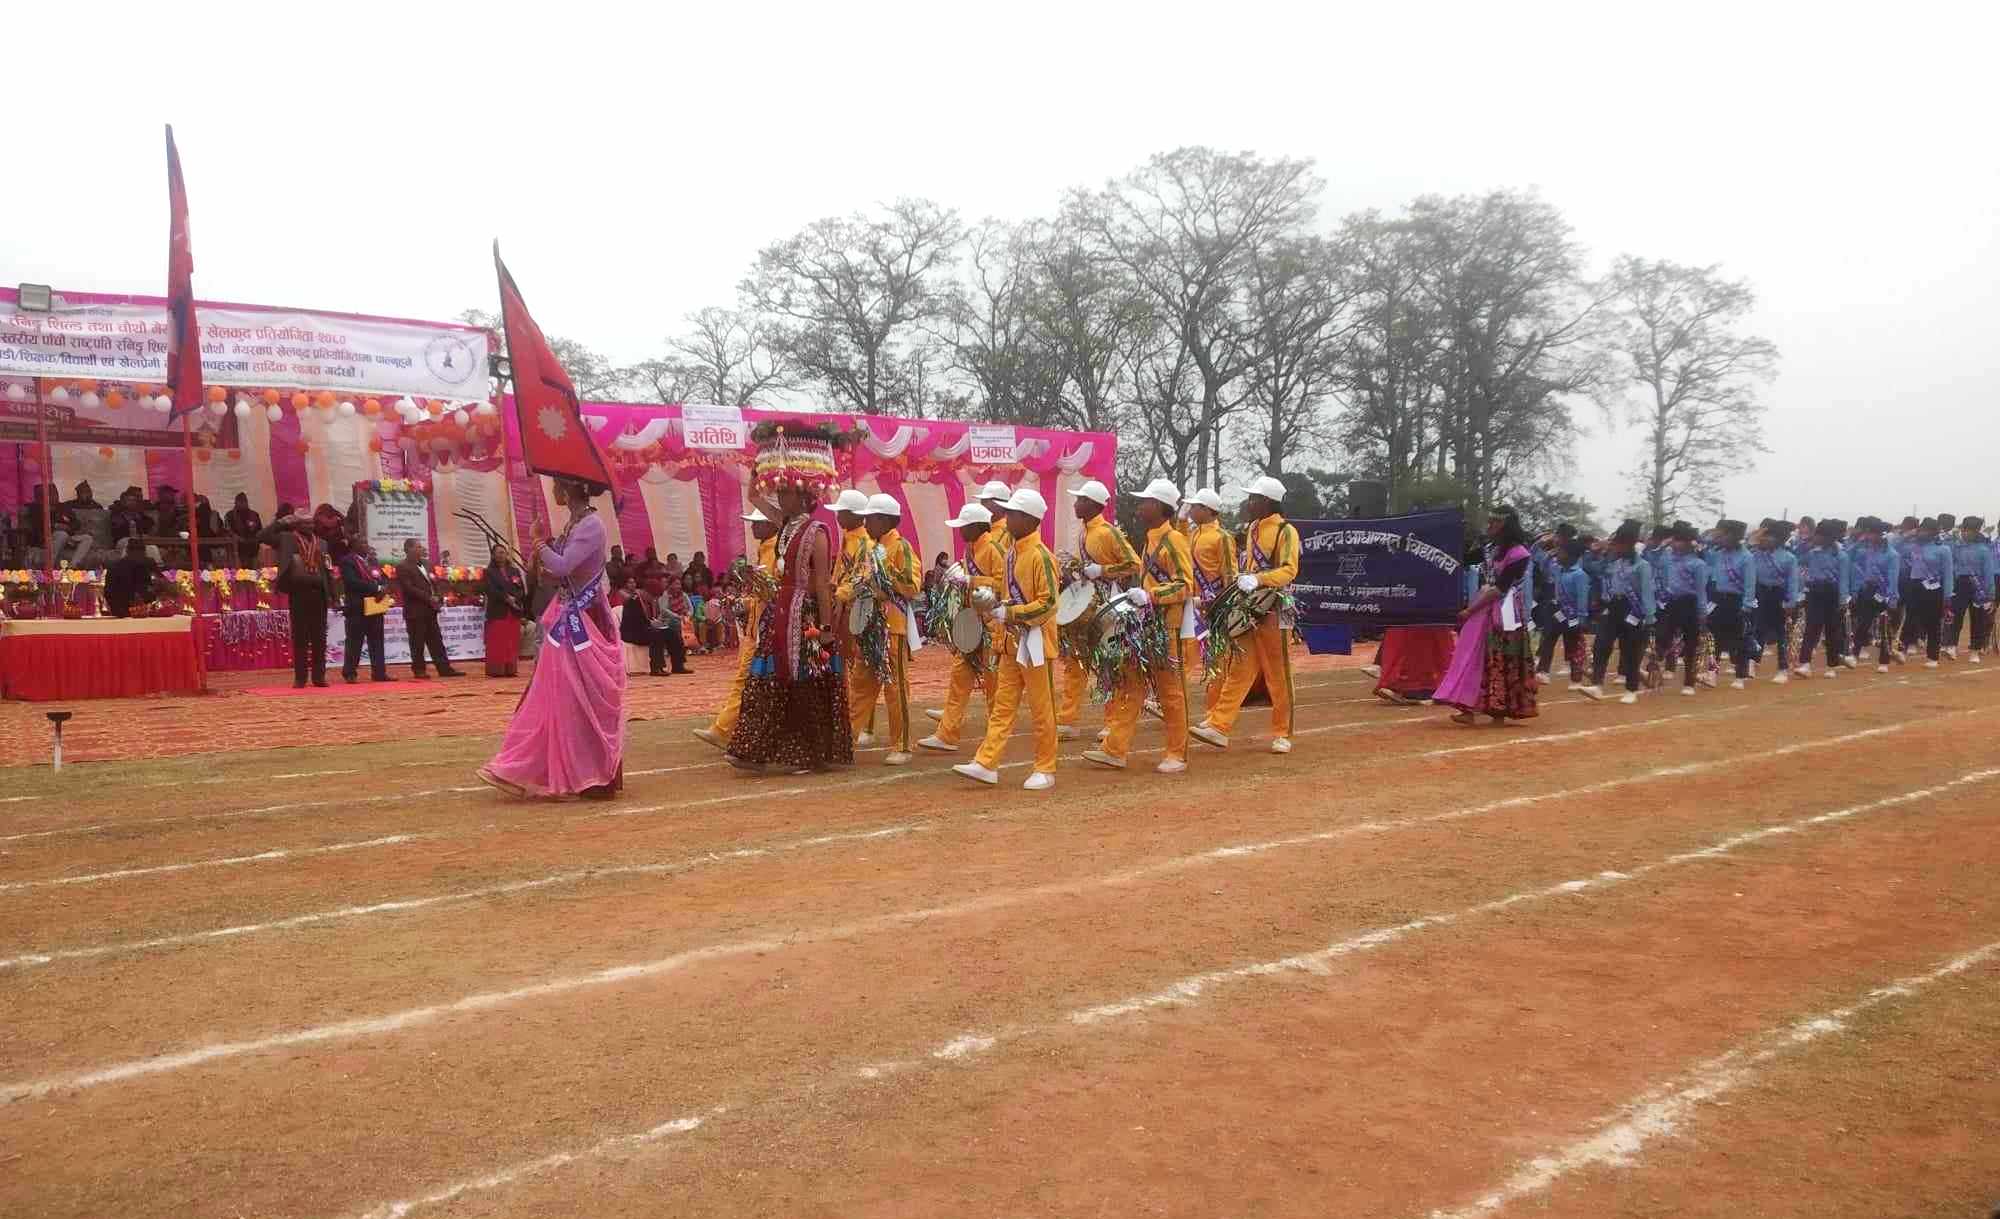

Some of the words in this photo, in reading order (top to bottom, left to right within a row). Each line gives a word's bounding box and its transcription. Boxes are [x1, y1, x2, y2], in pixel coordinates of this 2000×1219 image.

[87, 322, 113, 332] तथा
[688, 427, 736, 445] अतिथि
[971, 446, 1014, 460] पत्रकार
[1405, 532, 1461, 575] विद्यालय
